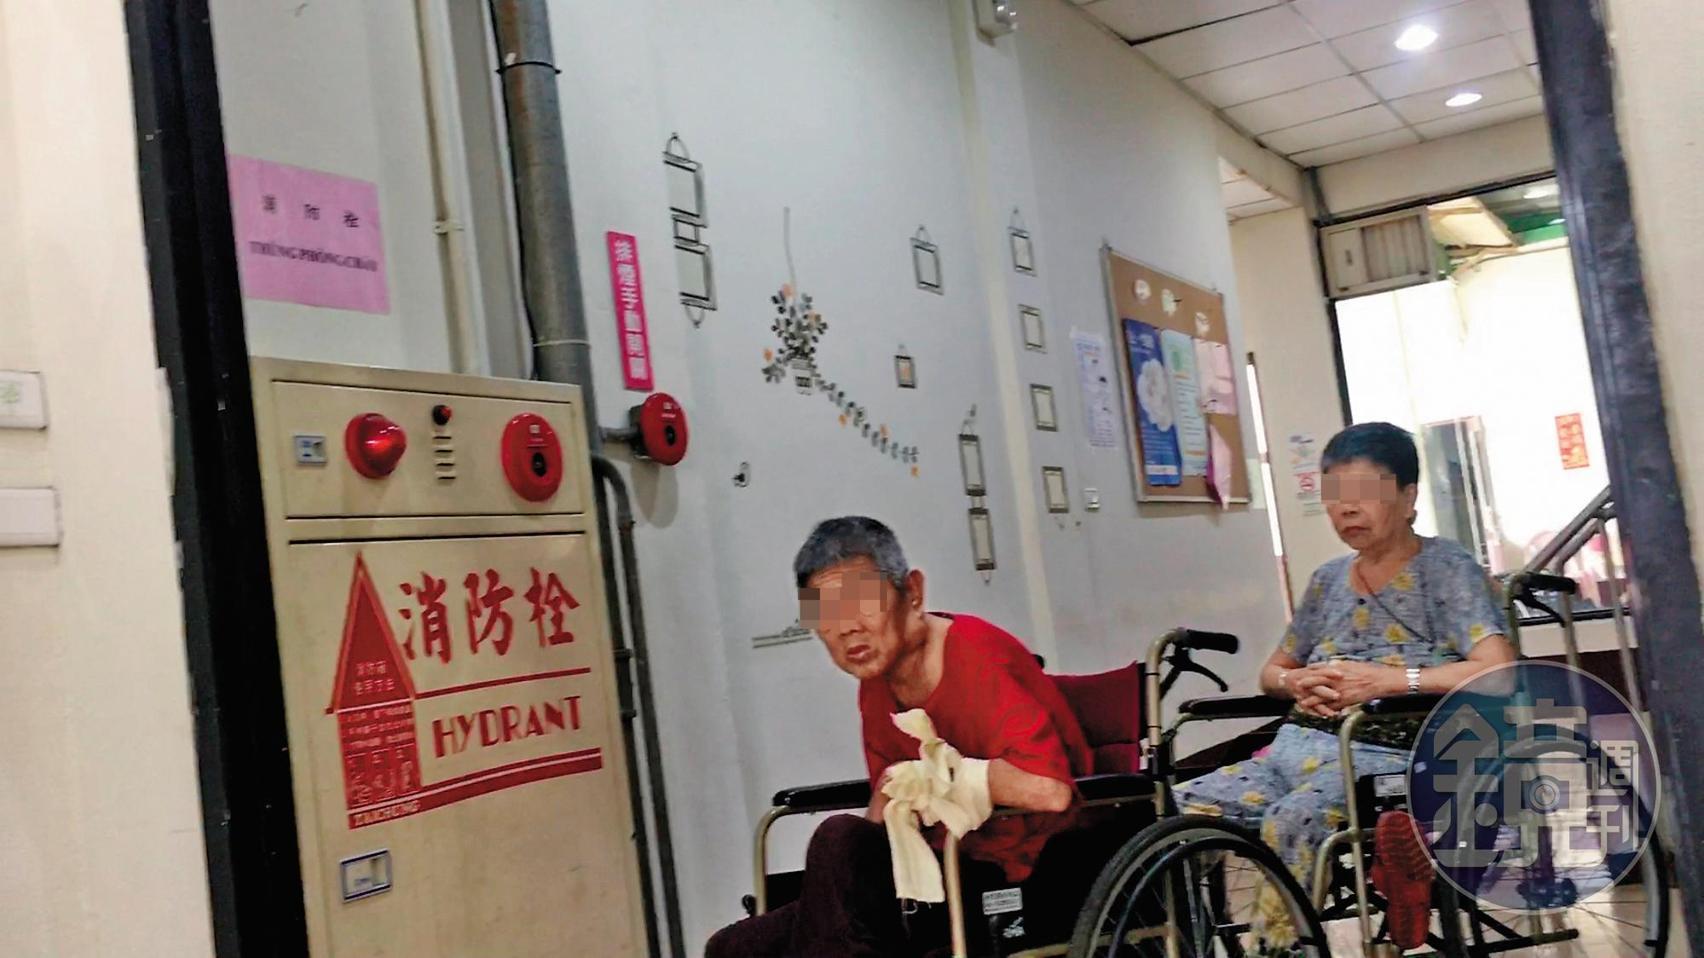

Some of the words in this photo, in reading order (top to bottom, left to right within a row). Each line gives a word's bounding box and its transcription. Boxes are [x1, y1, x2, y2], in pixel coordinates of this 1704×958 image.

[398, 566, 581, 664] 消防栓
[431, 695, 581, 758] HYDRANT
